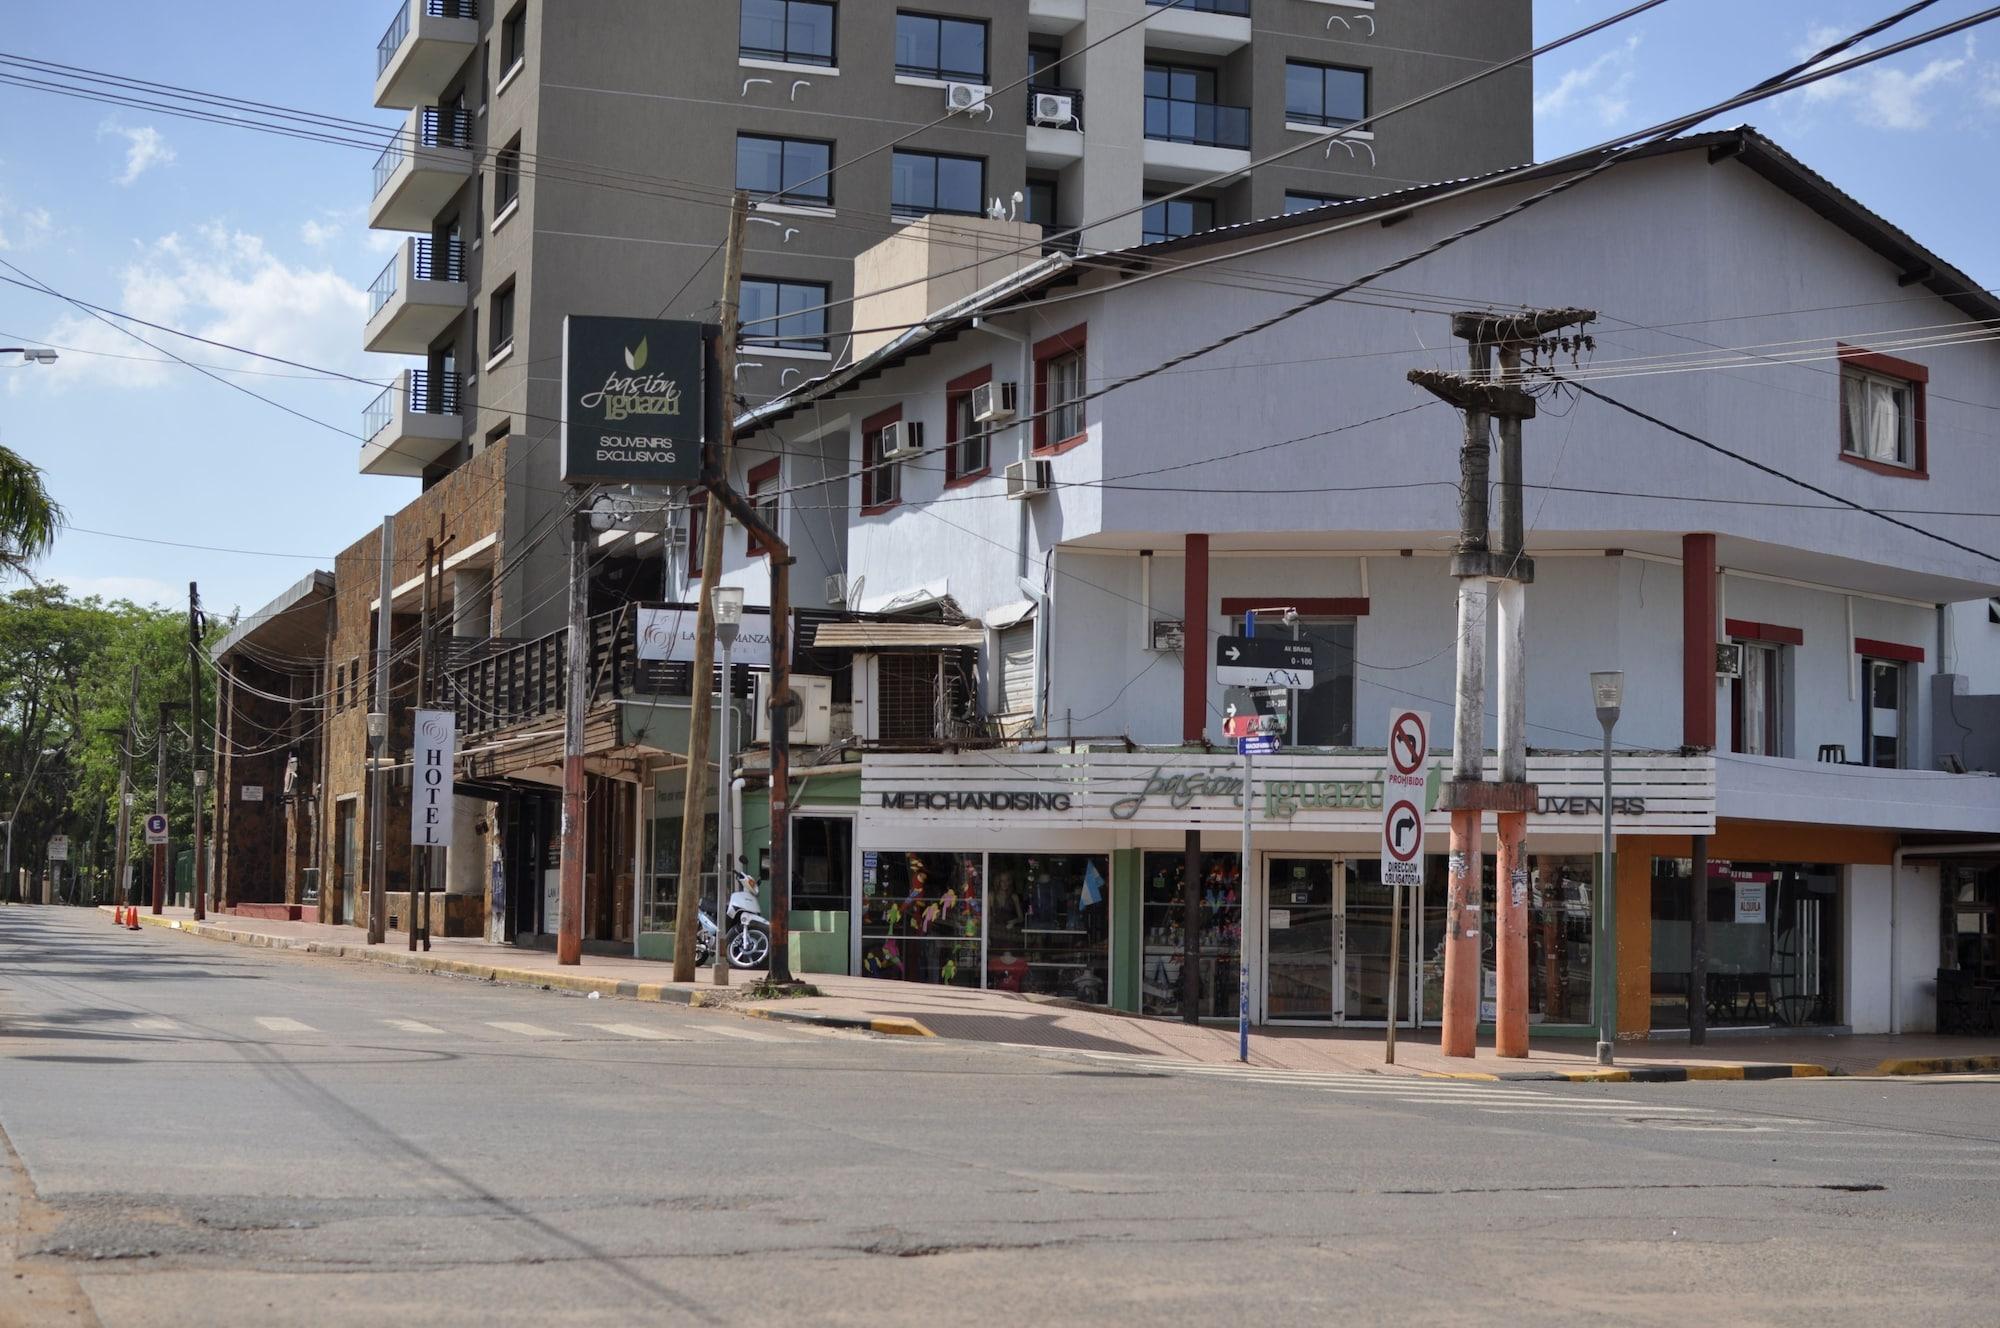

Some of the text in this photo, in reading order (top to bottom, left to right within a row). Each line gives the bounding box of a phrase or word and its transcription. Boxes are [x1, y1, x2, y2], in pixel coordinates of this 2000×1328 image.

[581, 371, 681, 408] pasión
[600, 436, 672, 449] SOUVENIRS
[597, 450, 676, 463] EXCLUSIVOS
[682, 631, 696, 641] LA
[736, 633, 772, 643] MANZA
[1291, 657, 1297, 665] 0
[1301, 657, 1313, 666] 100
[1389, 774, 1424, 787] PROHIBIDO
[425, 749, 442, 844] HOTEL
[1264, 768, 1385, 818] Iguazú
[881, 791, 1072, 812] MERCHANDISING
[1537, 796, 1645, 815] UVENRS
[1388, 862, 1417, 874] DIRECCION
[1385, 873, 1420, 886] OBLIGATORIA
